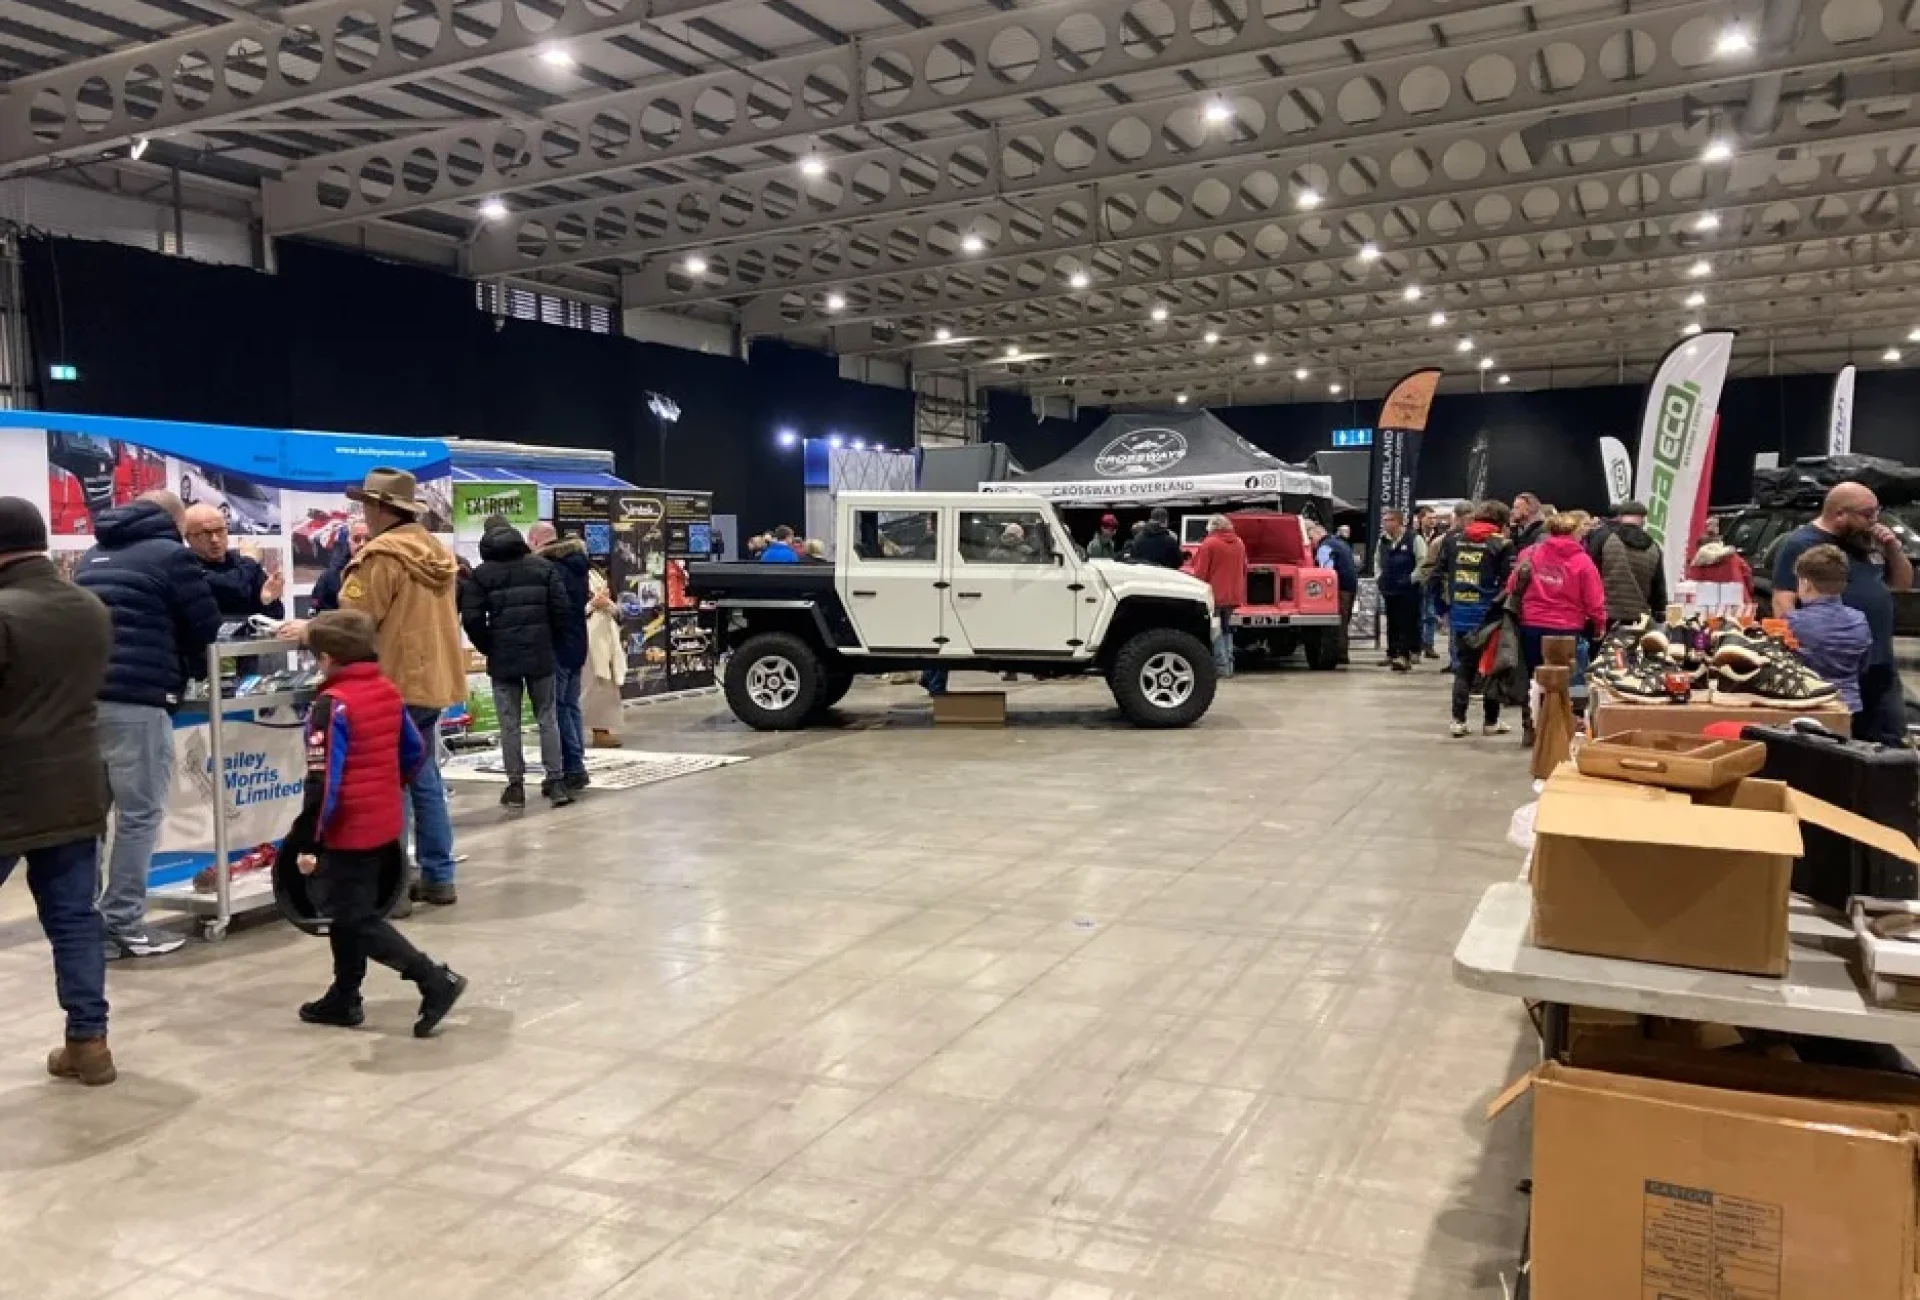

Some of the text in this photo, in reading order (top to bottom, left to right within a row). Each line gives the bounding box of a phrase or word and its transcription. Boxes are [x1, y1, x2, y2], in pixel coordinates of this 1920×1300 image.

[1659, 394, 1690, 460] ECO
[1382, 429, 1394, 504] OVERLAND
[1051, 480, 1195, 497] CROSSWAYS OVERLAND
[464, 497, 523, 516] EXTREME
[223, 767, 279, 789] Morris
[235, 779, 302, 806] Limited
